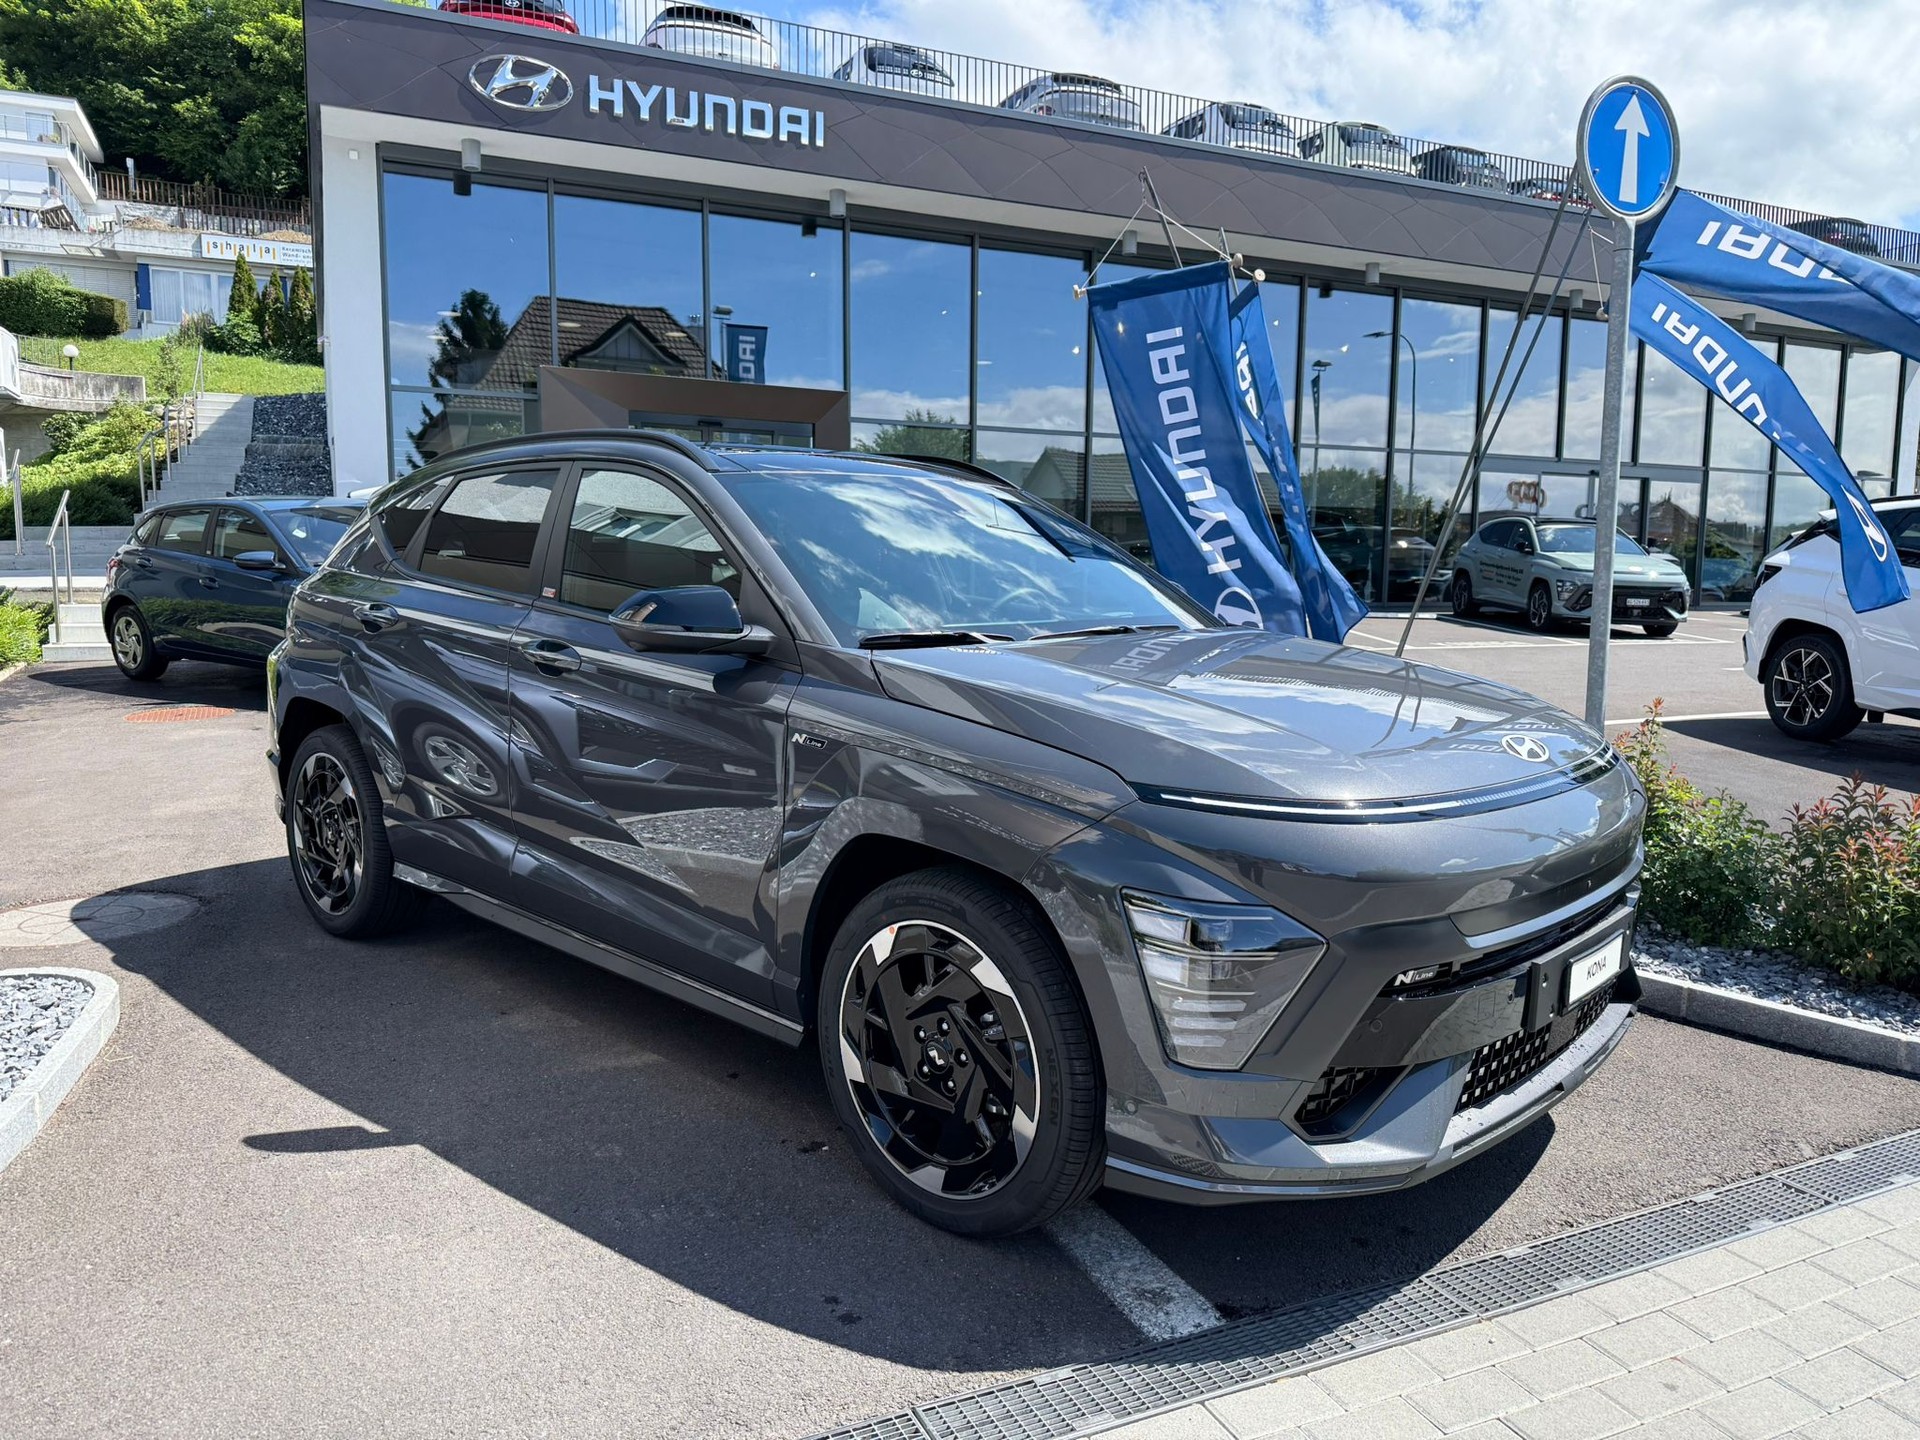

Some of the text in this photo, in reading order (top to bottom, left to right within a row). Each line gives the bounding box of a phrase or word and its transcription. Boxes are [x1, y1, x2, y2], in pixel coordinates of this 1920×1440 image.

[589, 74, 825, 147] HYUNDAI
[212, 241, 271, 255] shala
[1146, 326, 1242, 575] HYUNDAI
[1415, 971, 1434, 981] Line
[1586, 955, 1607, 981] KONA
[1046, 1048, 1060, 1128] NEXEN
